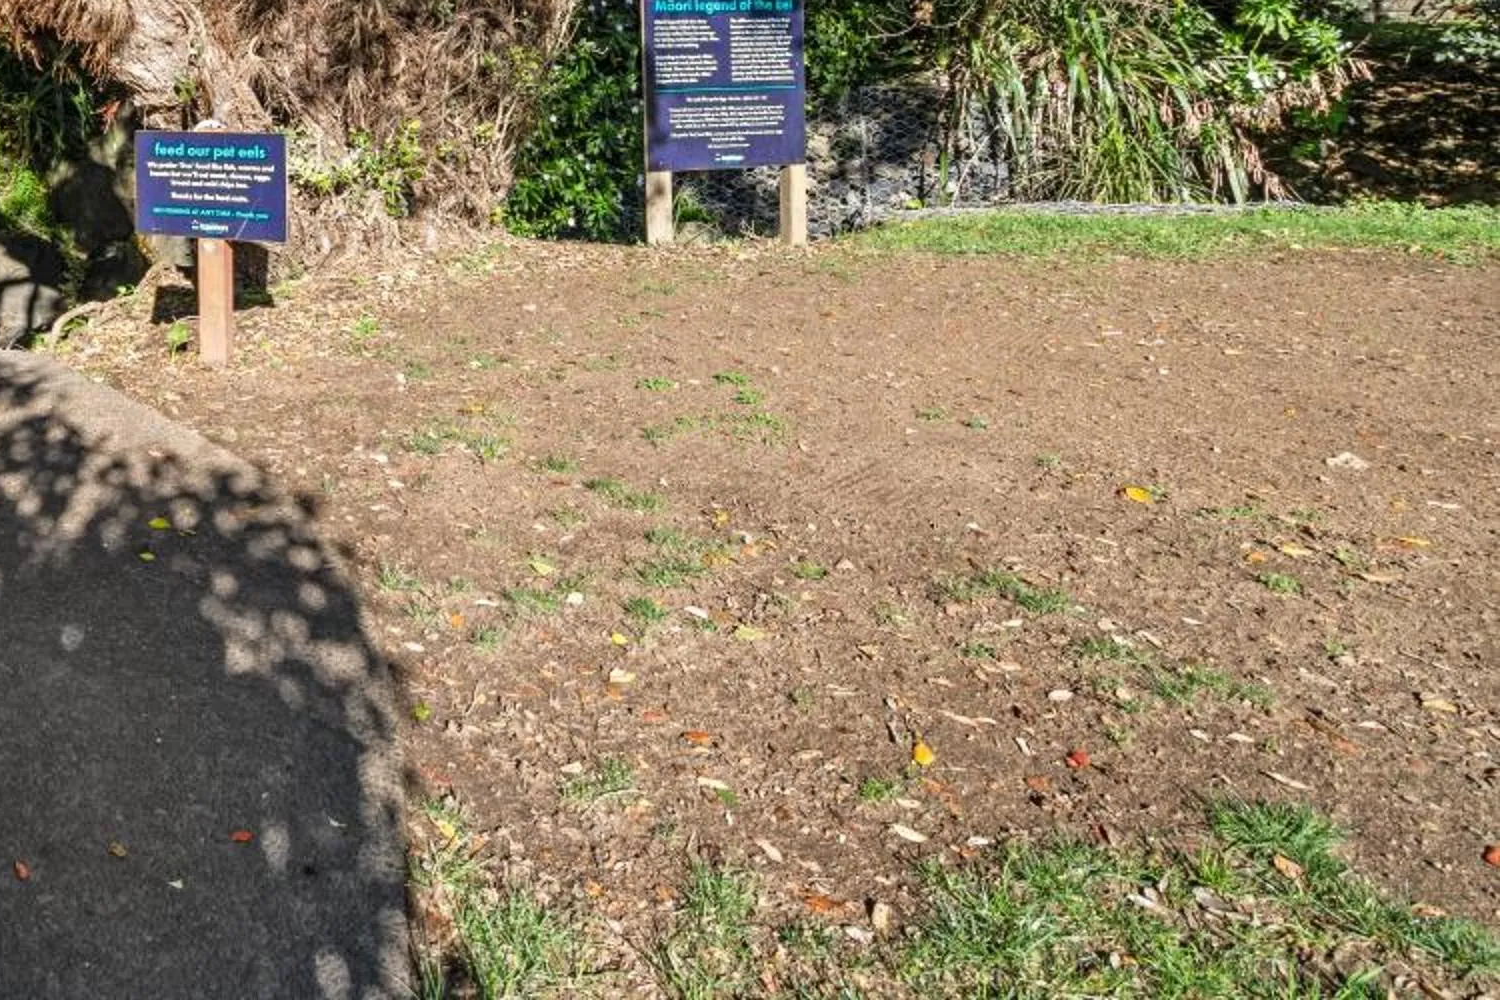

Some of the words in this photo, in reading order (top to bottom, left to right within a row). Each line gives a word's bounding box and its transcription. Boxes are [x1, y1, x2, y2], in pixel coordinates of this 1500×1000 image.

[155, 142, 185, 157] feed
[187, 146, 210, 157] our
[213, 145, 235, 160] pet
[238, 144, 266, 159] eels
